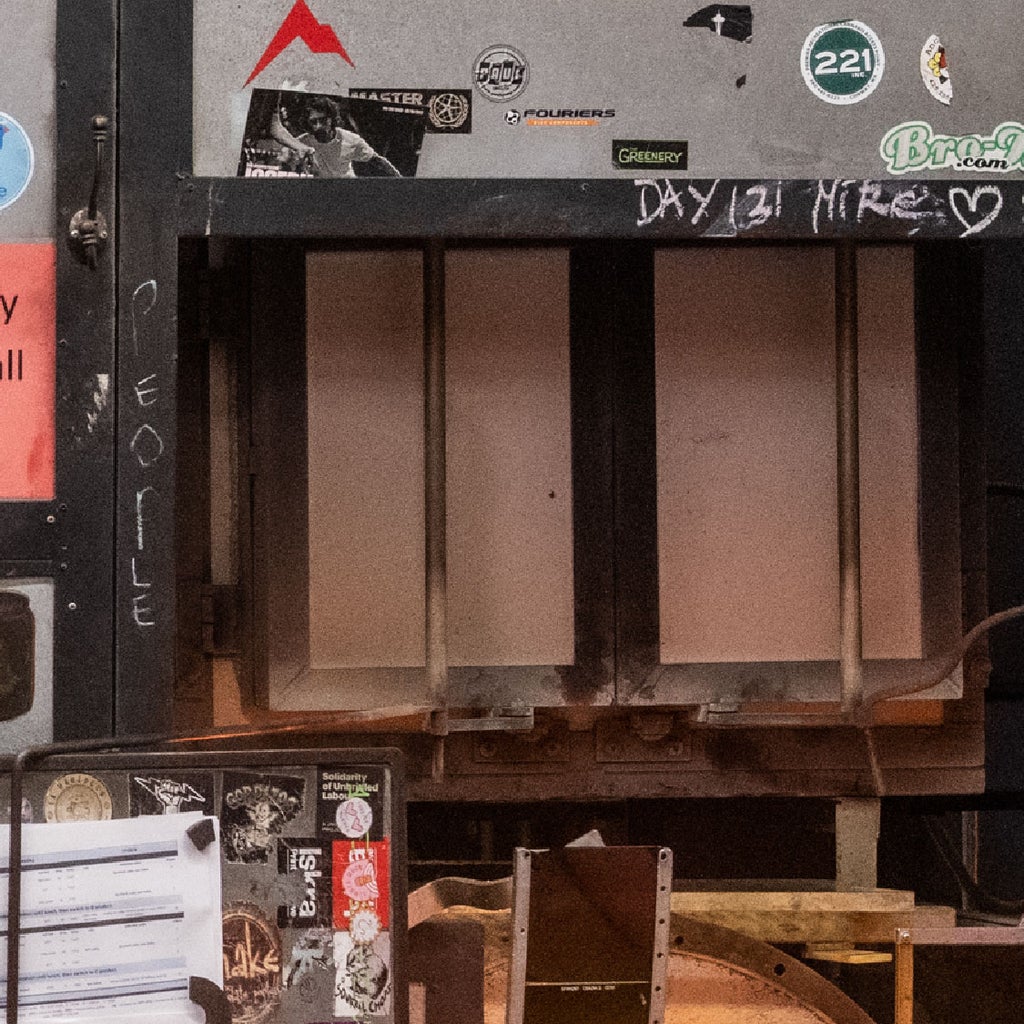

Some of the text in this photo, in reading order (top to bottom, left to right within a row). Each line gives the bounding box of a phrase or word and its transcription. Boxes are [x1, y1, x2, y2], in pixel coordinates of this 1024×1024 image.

[815, 49, 872, 75] 221
[523, 109, 616, 118] FOURIERS
[618, 148, 683, 164] GREENERY
[956, 157, 1009, 169] .com
[634, 179, 720, 226] DAY
[322, 772, 368, 783] Solidarity
[322, 782, 379, 793] of Unbled
[322, 792, 352, 801] Labou
[299, 848, 322, 918] Iskra
